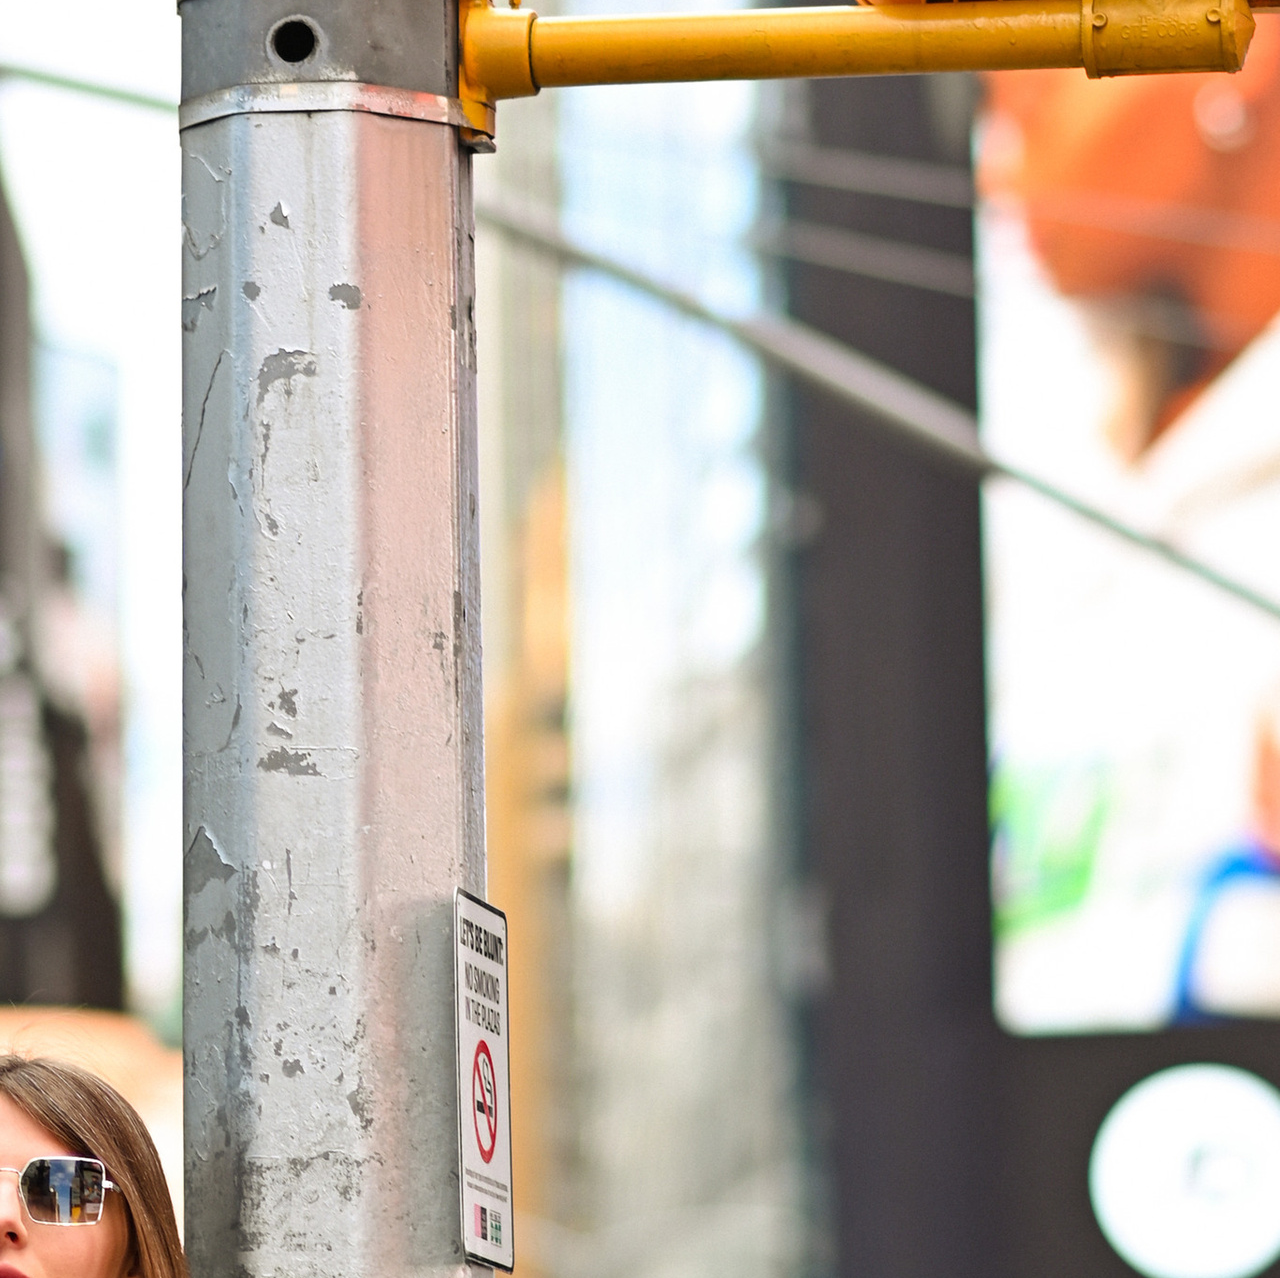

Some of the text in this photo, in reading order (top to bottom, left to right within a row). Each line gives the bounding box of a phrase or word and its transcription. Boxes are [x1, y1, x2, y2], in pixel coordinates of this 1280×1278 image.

[1121, 24, 1148, 39] GTE
[459, 915, 475, 950] LET'S
[475, 924, 483, 955] BE
[465, 961, 500, 1004] NO SMOKING
[465, 995, 500, 1036] IN THE PLAZAS
